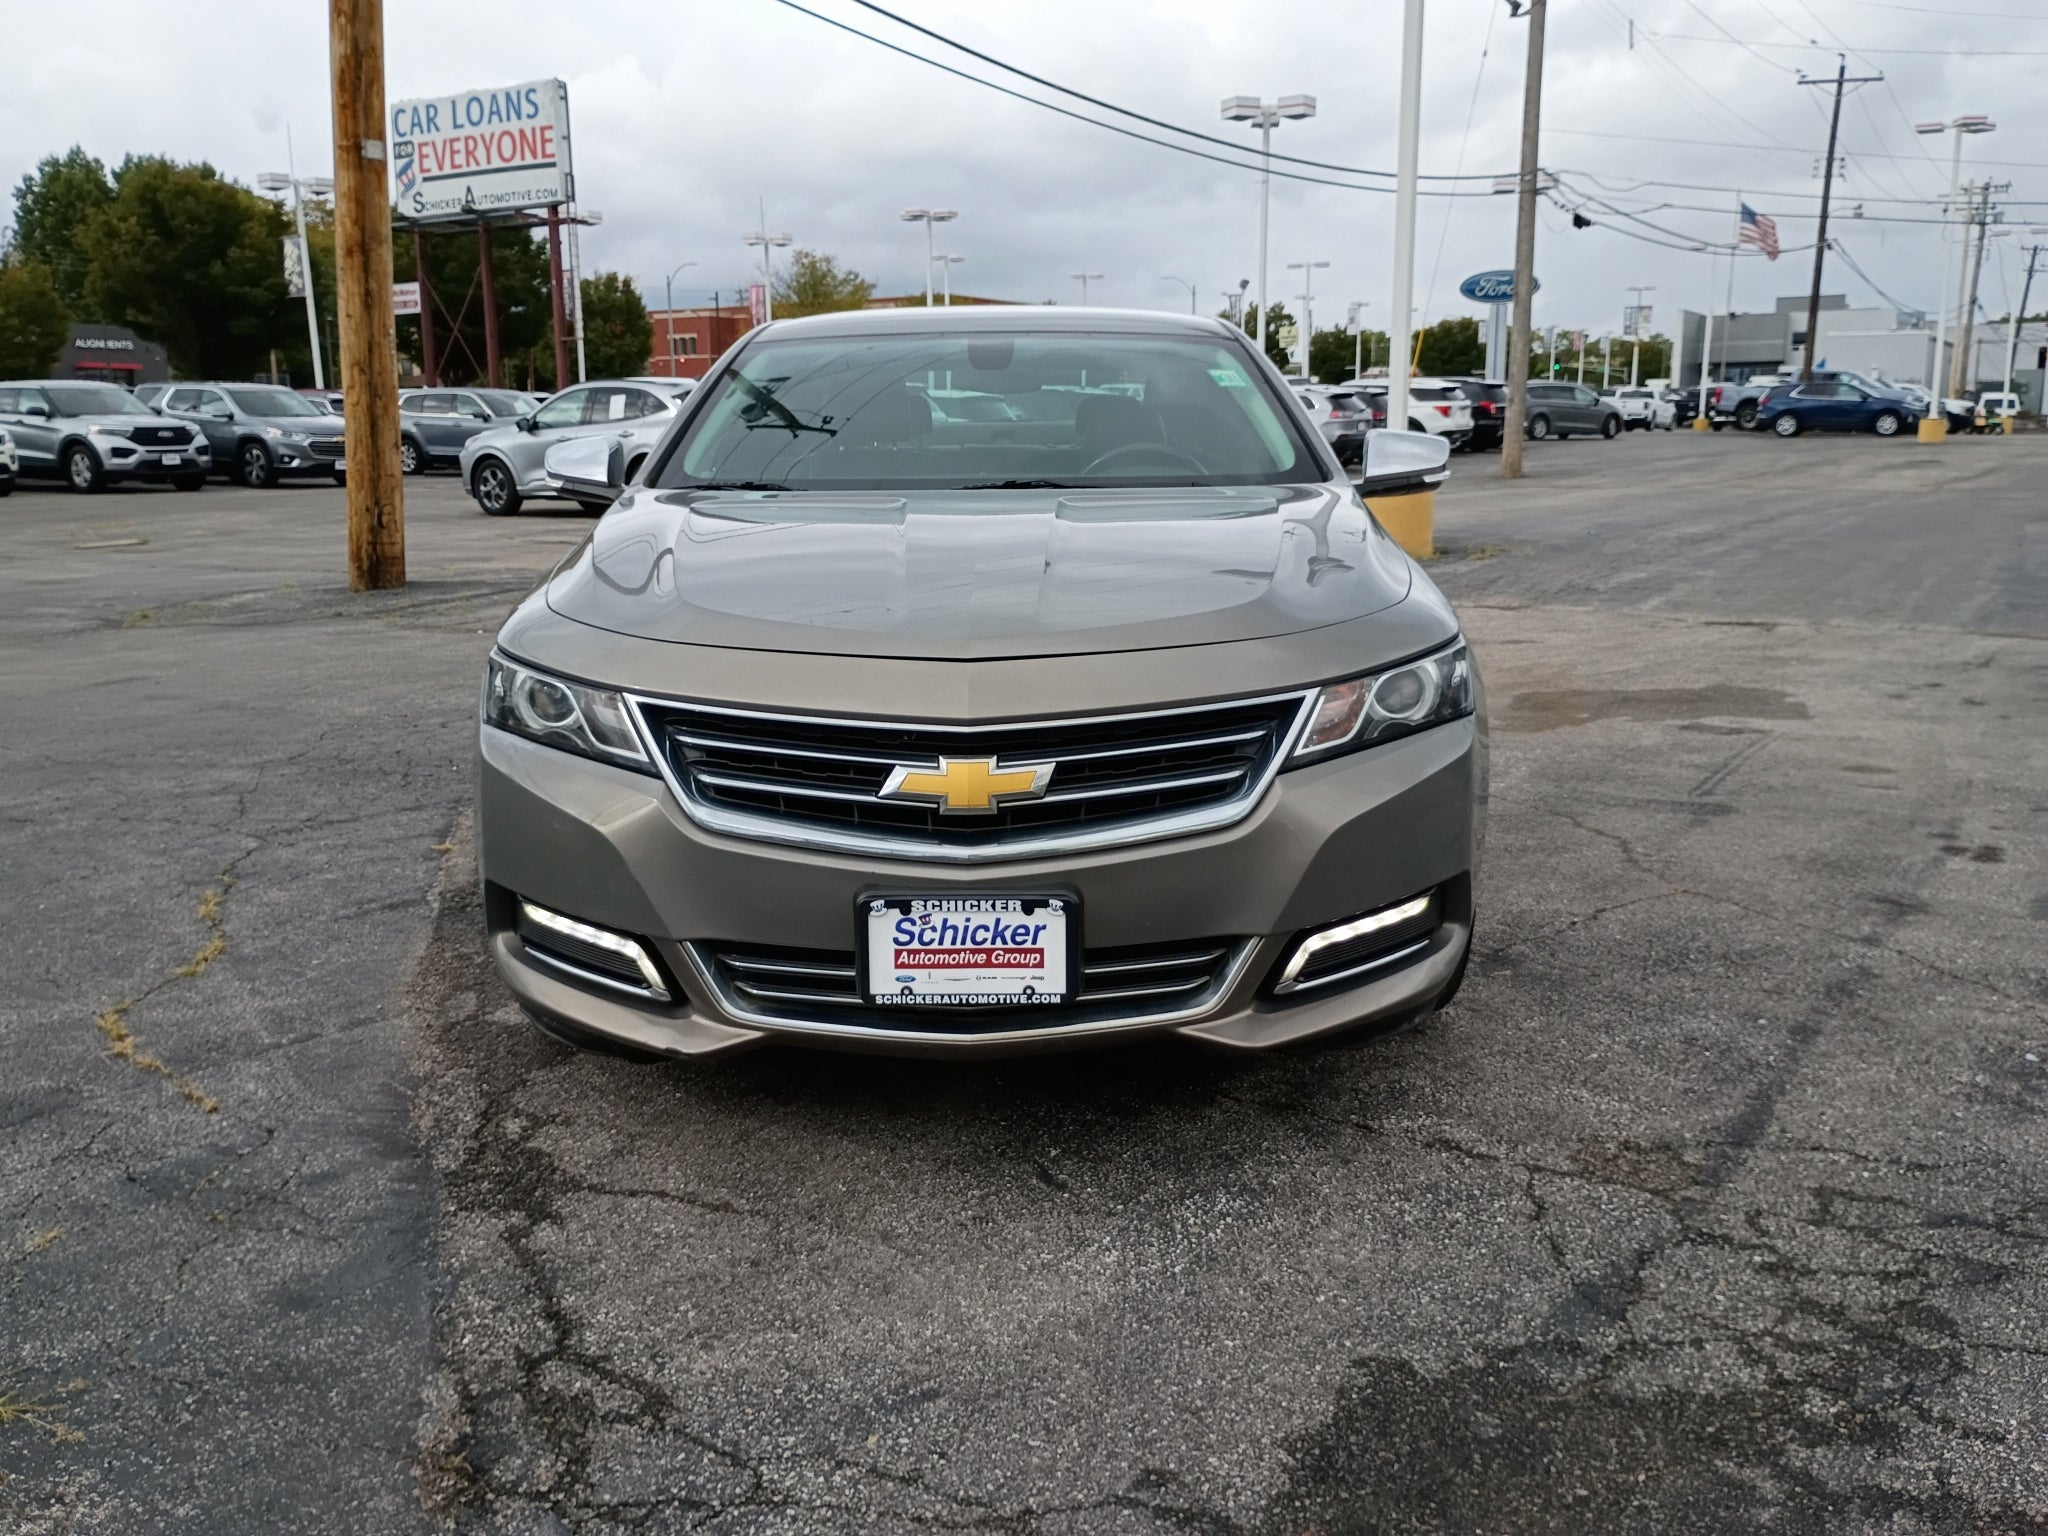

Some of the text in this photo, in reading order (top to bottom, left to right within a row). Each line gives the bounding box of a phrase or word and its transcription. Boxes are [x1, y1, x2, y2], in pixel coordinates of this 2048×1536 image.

[394, 88, 540, 138] CAR LOANS
[417, 125, 556, 174] EVERYONE
[910, 900, 1022, 912] SCHICKER
[892, 916, 1047, 947] Schicker
[897, 950, 1041, 967] Automotive Group
[875, 993, 1061, 1005] SCHICKERAUTOMOTIVE.COM
